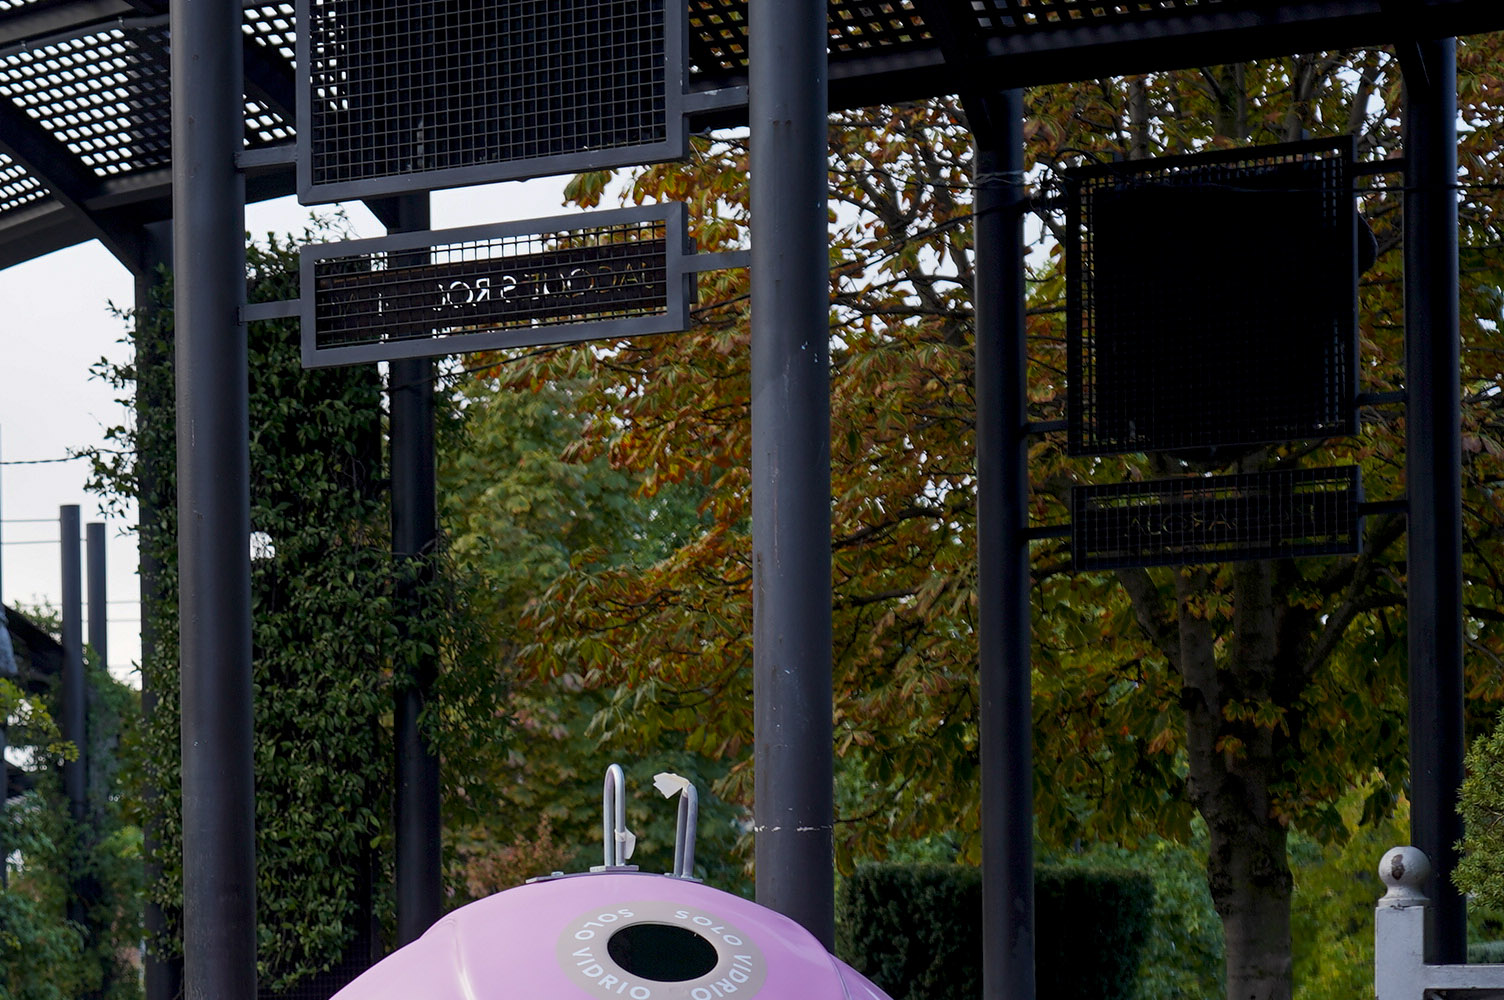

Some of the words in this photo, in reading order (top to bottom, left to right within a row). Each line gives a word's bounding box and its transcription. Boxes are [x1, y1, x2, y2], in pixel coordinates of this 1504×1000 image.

[574, 908, 635, 941] SOLO
[674, 910, 743, 947] SOLO
[572, 946, 651, 1000] VIDRIO
